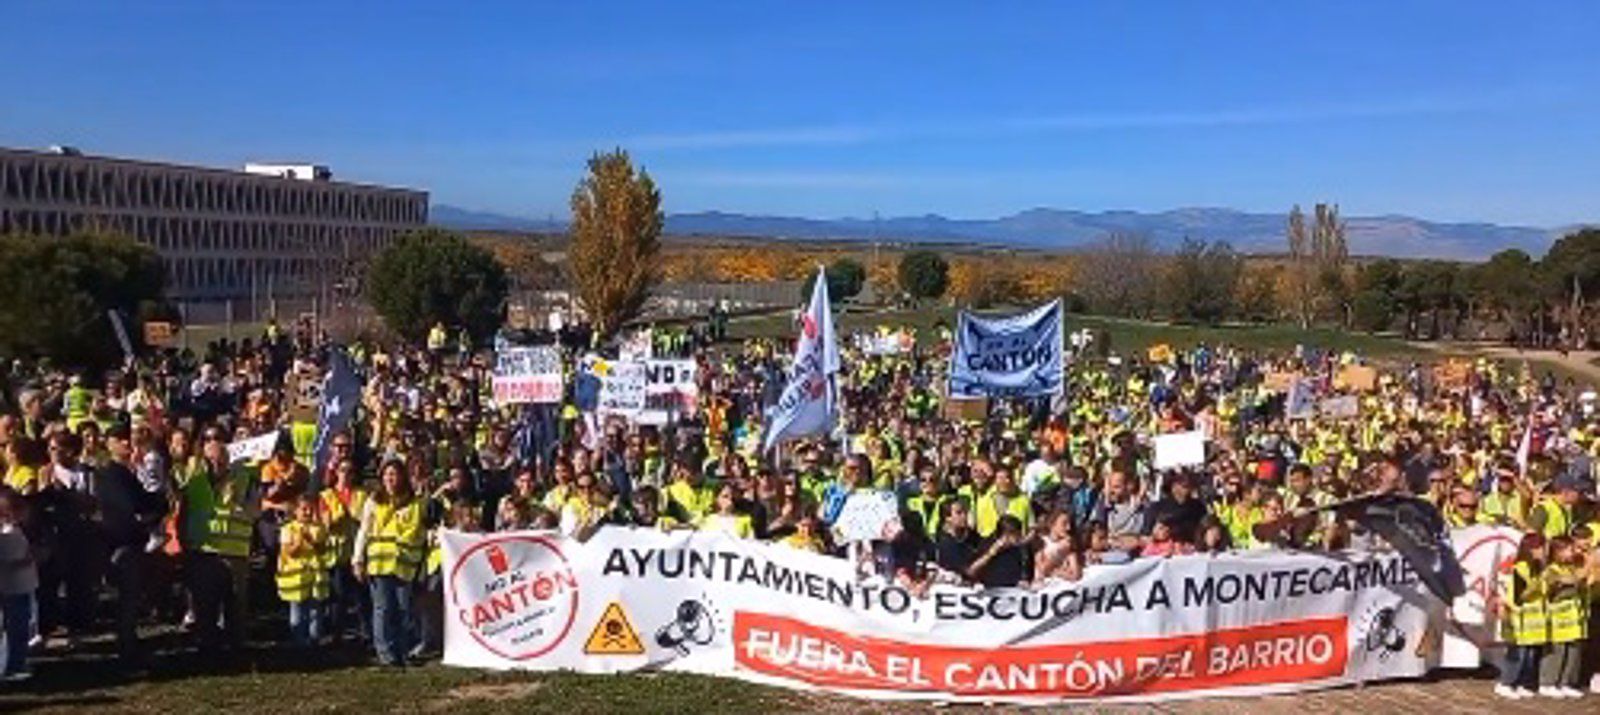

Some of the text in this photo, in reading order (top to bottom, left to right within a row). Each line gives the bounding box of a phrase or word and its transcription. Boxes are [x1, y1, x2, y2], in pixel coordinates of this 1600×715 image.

[602, 548, 920, 623] AYUNTAMIENTO,
[934, 583, 1134, 621] ESCUCHA
[1146, 587, 1170, 611] A
[1183, 557, 1418, 607] MONTECARME
[745, 627, 1334, 692] FUERA EL CANTÓN DEL BARRIO
